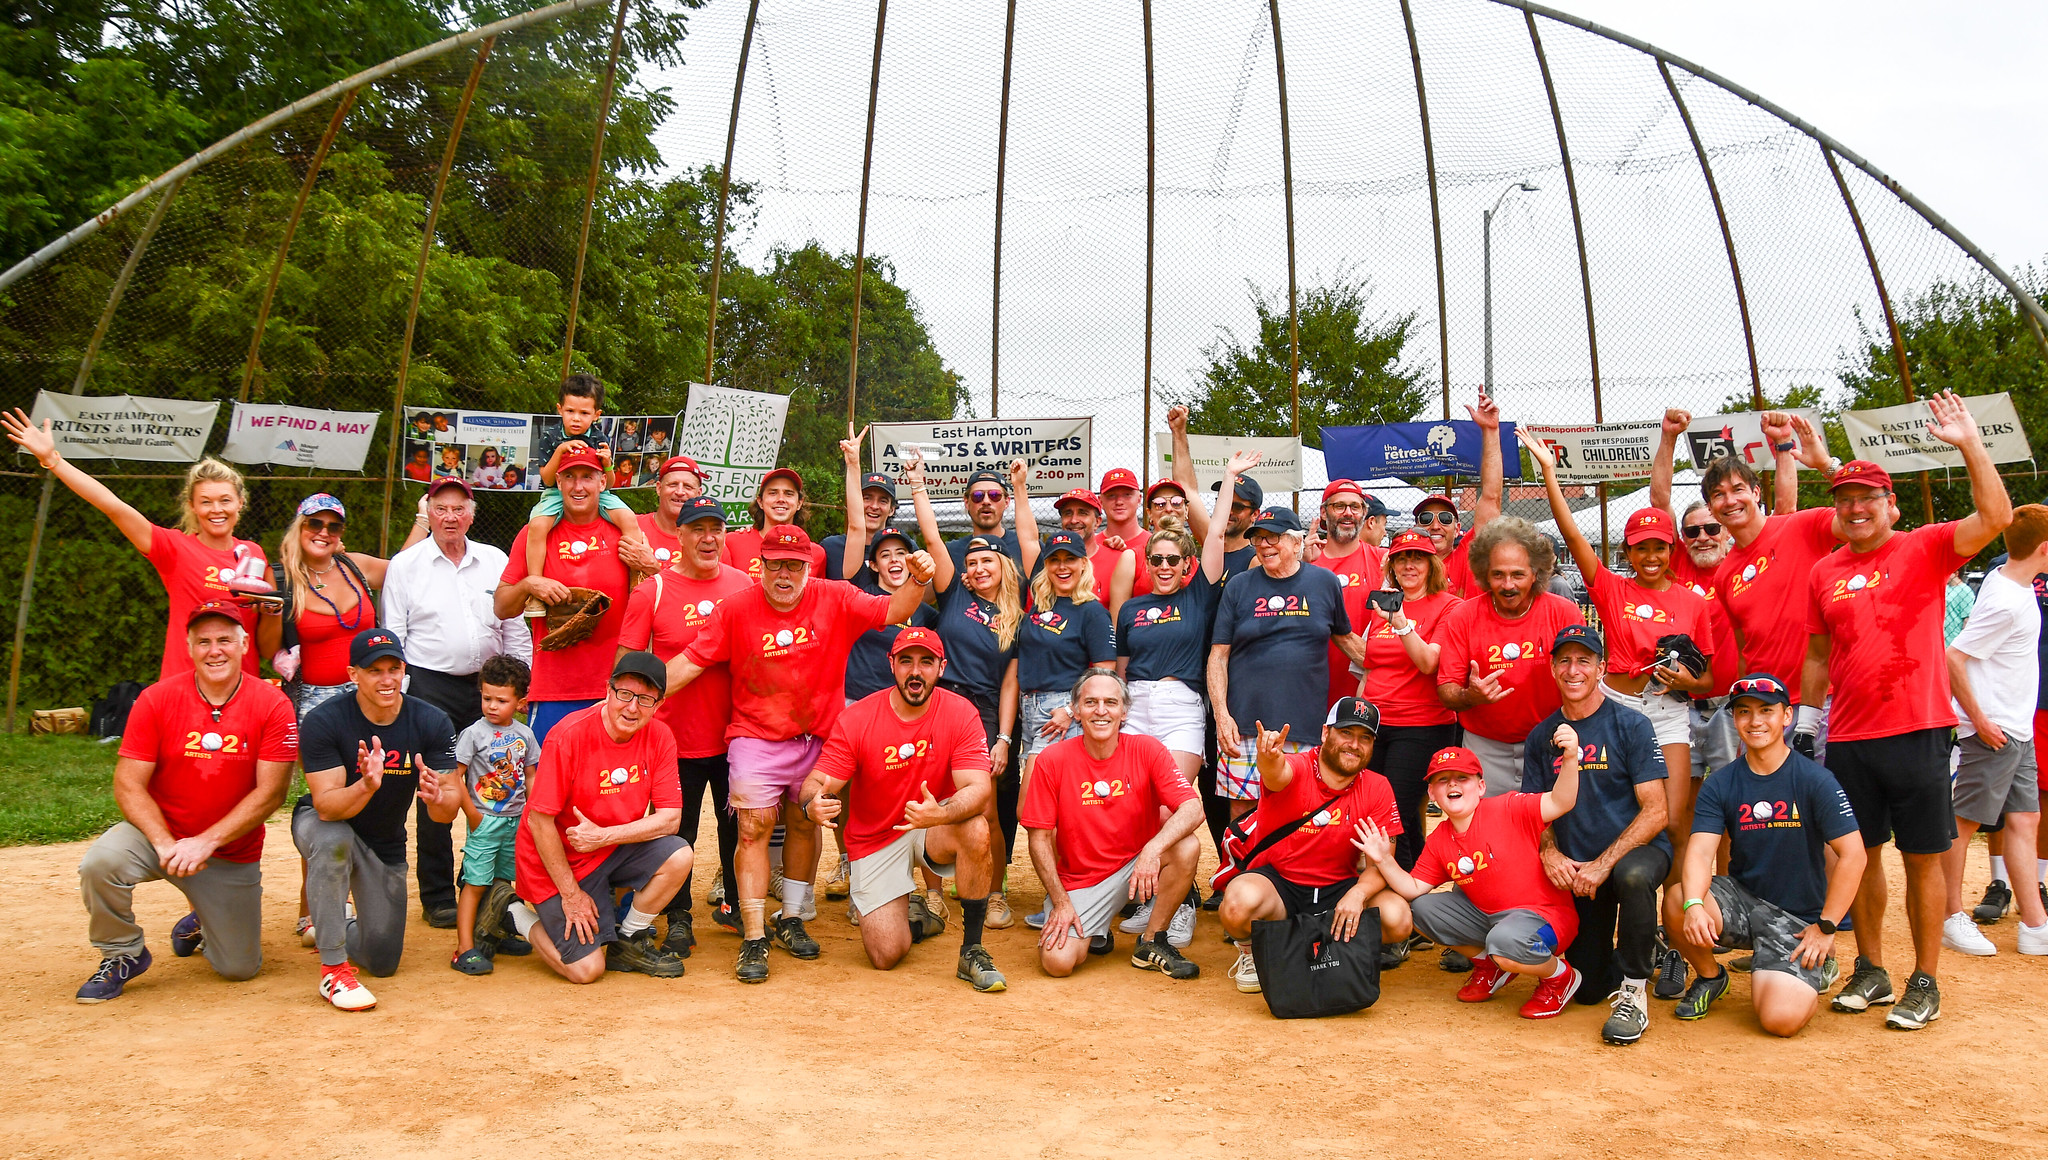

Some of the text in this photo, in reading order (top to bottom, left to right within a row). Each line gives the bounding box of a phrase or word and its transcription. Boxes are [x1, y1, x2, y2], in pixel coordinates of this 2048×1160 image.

[78, 411, 176, 422] EAST HAMPTON
[251, 415, 370, 434] WE FIND A WAY
[1527, 422, 1661, 434] FirstRespondersThankYou.com
[1881, 422, 1911, 432] EAST
[115, 424, 126, 433] &
[131, 424, 203, 438] WRITERS
[932, 425, 1032, 438] East Hampton
[59, 435, 175, 447] Annual Softball Game
[1602, 436, 1649, 444] RESPONDERS
[1858, 433, 1921, 447] ARTISTS
[1925, 432, 1935, 442] &
[974, 442, 987, 456] &
[991, 436, 1081, 456] WRITERS
[1696, 438, 1729, 460] 75
[1384, 447, 1431, 460] retreat
[1583, 447, 1650, 461] CHILDREN'S
[1884, 448, 1921, 458] Annual
[923, 461, 973, 473] Annual
[1038, 455, 1082, 467] Game
[1256, 458, 1296, 467] rchitect
[703, 470, 725, 482] ST
[1035, 470, 1064, 480] 2:00
[1066, 471, 1085, 480] pm
[701, 485, 759, 498] OSPIC
[1733, 583, 1752, 598] ARTISTS
[1254, 594, 1309, 612] 2021
[1832, 592, 1856, 603] ARTISTS
[1253, 610, 1278, 618] ARTISTS
[1284, 609, 1310, 617] WRITERS
[1622, 614, 1644, 623] ARTISTS
[686, 619, 706, 627] ARTIST
[1158, 615, 1181, 624] WRITERS
[764, 649, 788, 658] ARTISTS
[1489, 662, 1514, 670] ARTISTS
[184, 750, 212, 760] ARTISTS
[885, 761, 909, 771] ARTISTS
[600, 787, 620, 795] ARTISTS
[1738, 799, 1800, 823] 2021
[1740, 823, 1766, 831] ARTISTS
[1773, 821, 1801, 829] WRITERS
[1310, 960, 1340, 971] THANK YOU
